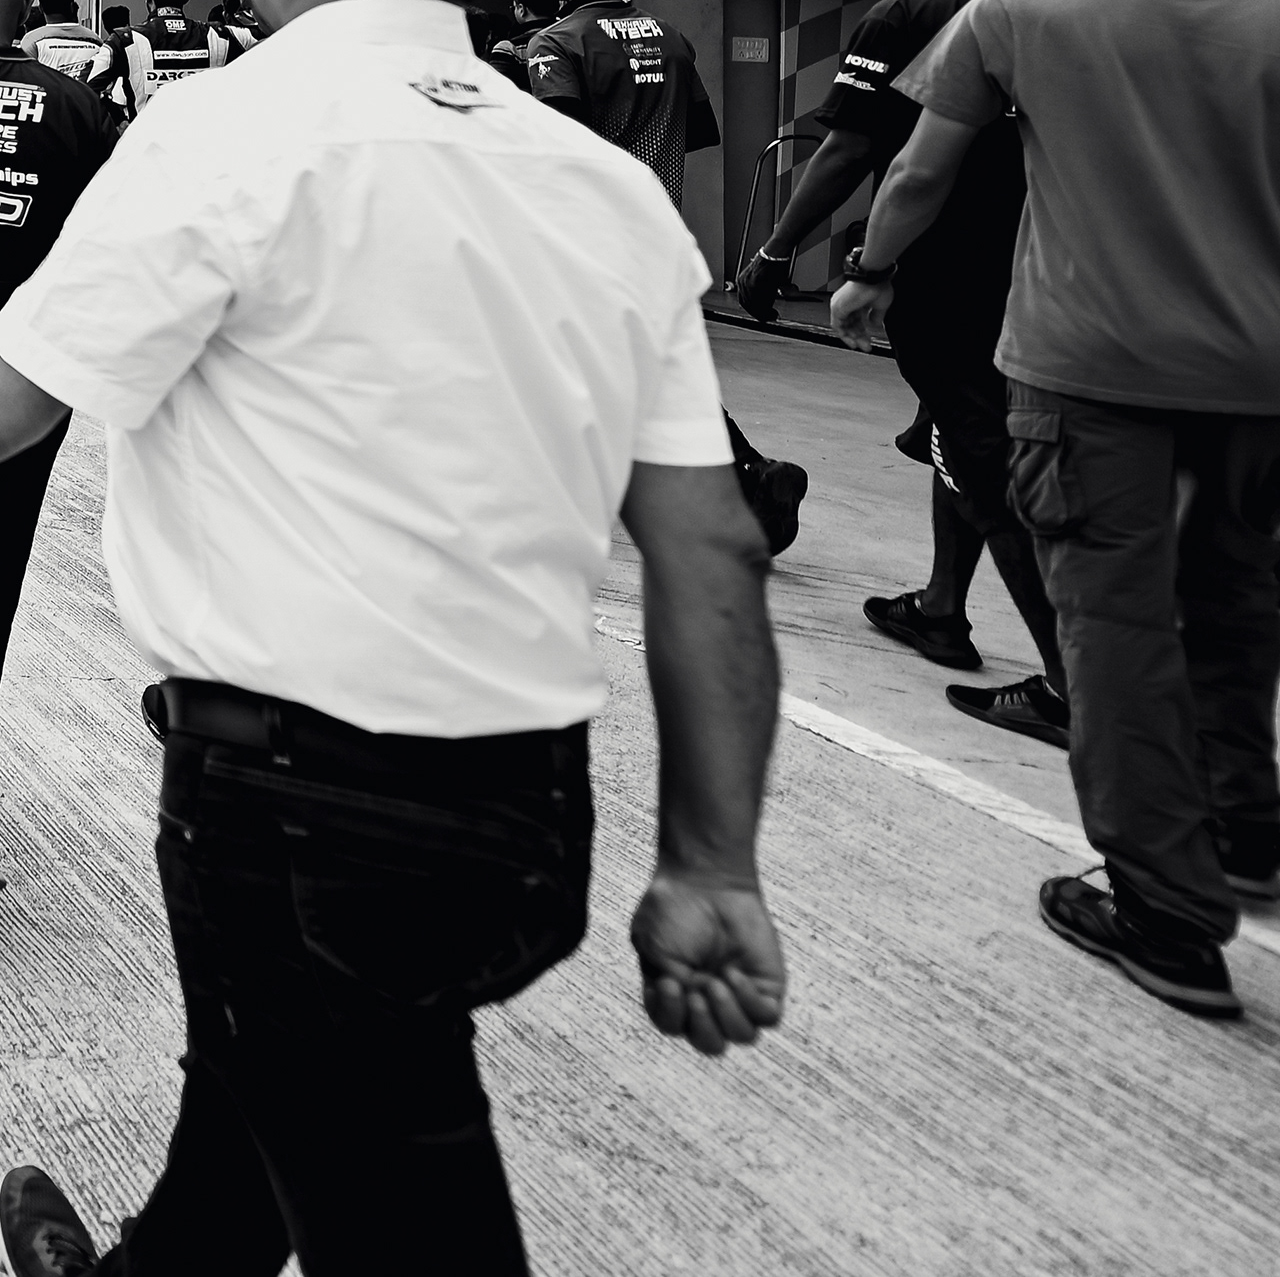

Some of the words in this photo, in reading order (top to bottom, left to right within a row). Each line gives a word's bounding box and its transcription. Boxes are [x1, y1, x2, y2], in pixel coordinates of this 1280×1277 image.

[165, 20, 186, 30] OMP
[616, 26, 664, 39] TECH
[845, 54, 885, 73] OTUL
